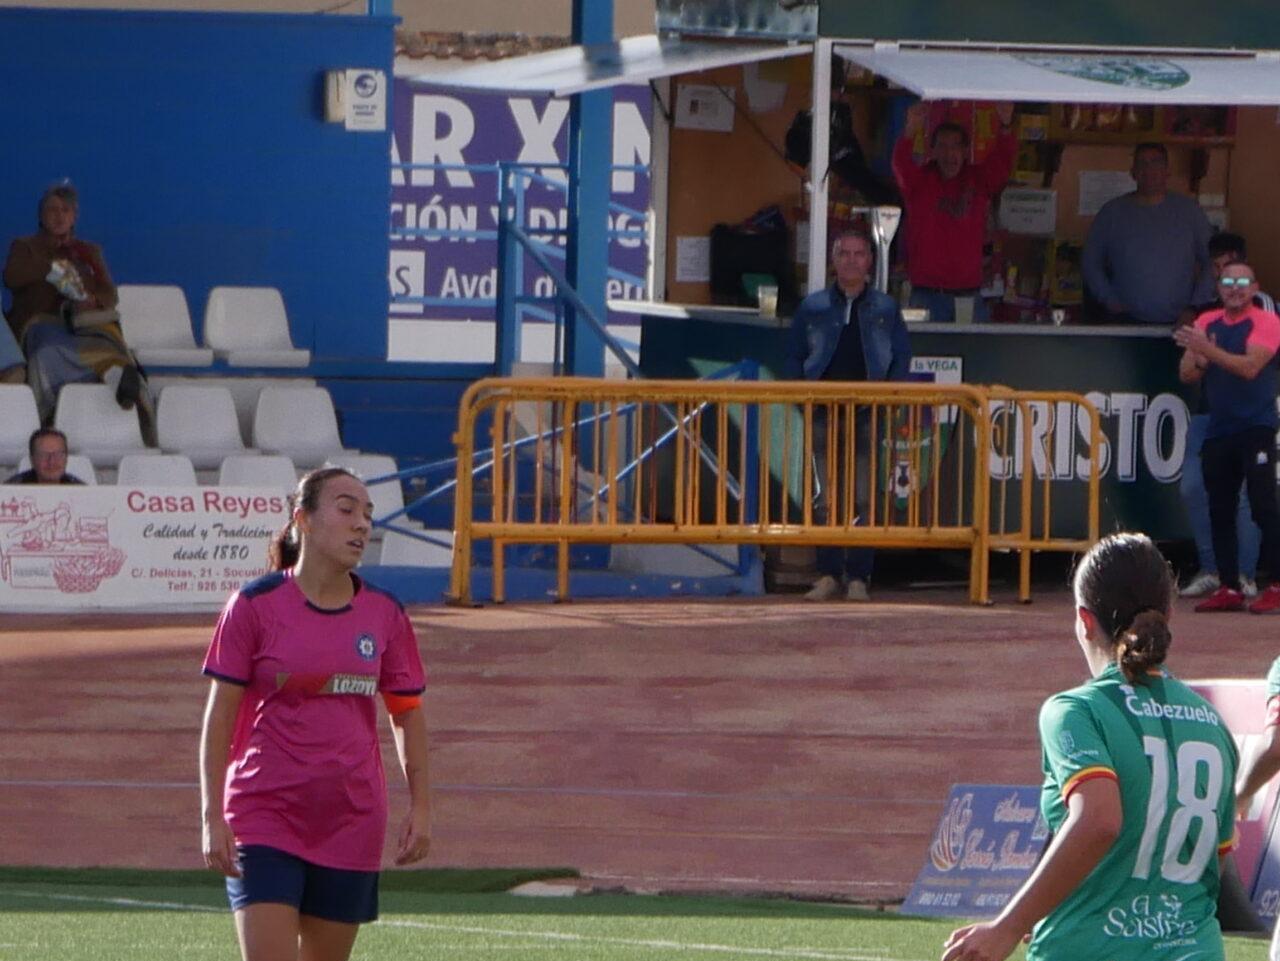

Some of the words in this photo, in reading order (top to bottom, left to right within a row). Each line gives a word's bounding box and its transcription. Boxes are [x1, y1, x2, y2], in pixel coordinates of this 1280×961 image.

[926, 359, 959, 371] VEGA
[976, 391, 1191, 484] CRISTO
[127, 490, 195, 513] Casa
[203, 490, 283, 519] Reyes
[143, 522, 197, 539] Calidad
[200, 530, 208, 541] y
[212, 522, 273, 539] Tradición
[172, 546, 208, 561] desde
[212, 545, 249, 560] 1880
[1125, 693, 1218, 727] Cabezuelo
[1132, 735, 1224, 884] 18
